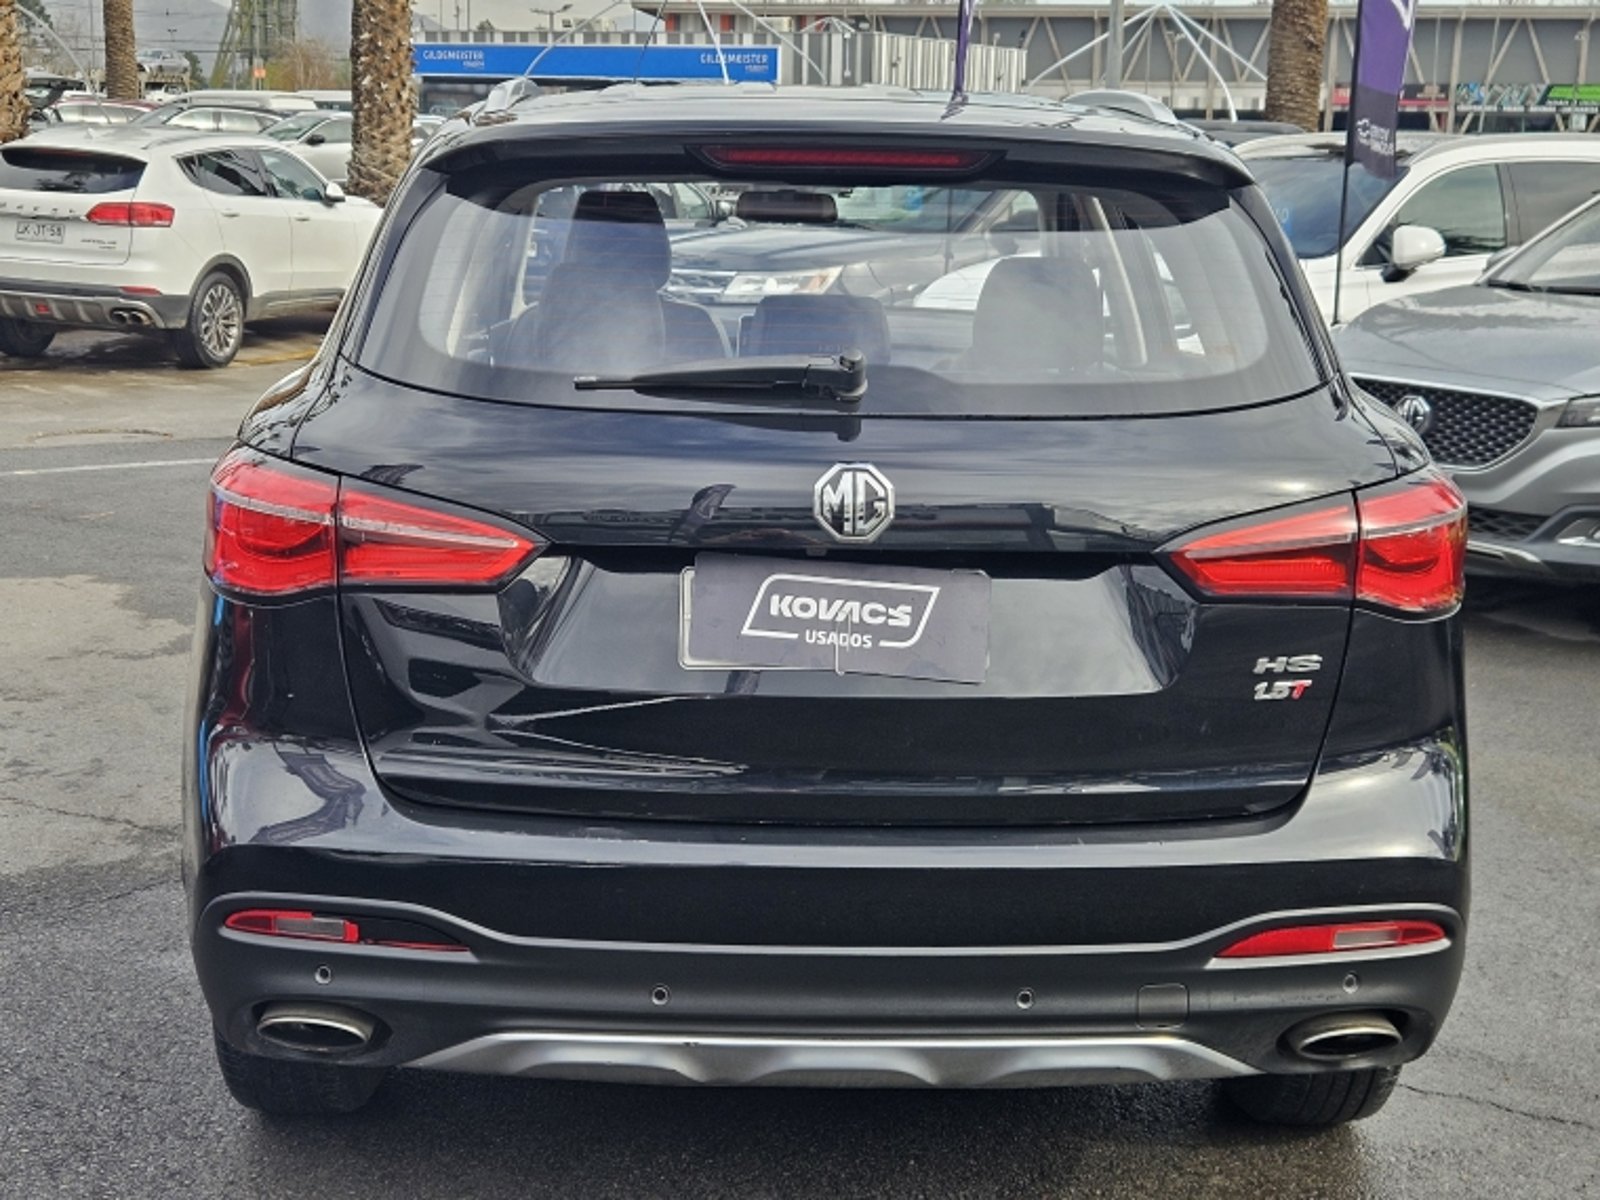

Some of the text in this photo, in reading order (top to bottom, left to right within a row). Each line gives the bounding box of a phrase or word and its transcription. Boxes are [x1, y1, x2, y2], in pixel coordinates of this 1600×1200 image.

[822, 471, 886, 535] MG
[770, 594, 912, 627] KOVACS
[805, 630, 872, 648] USADOS
[1252, 654, 1323, 674] HS
